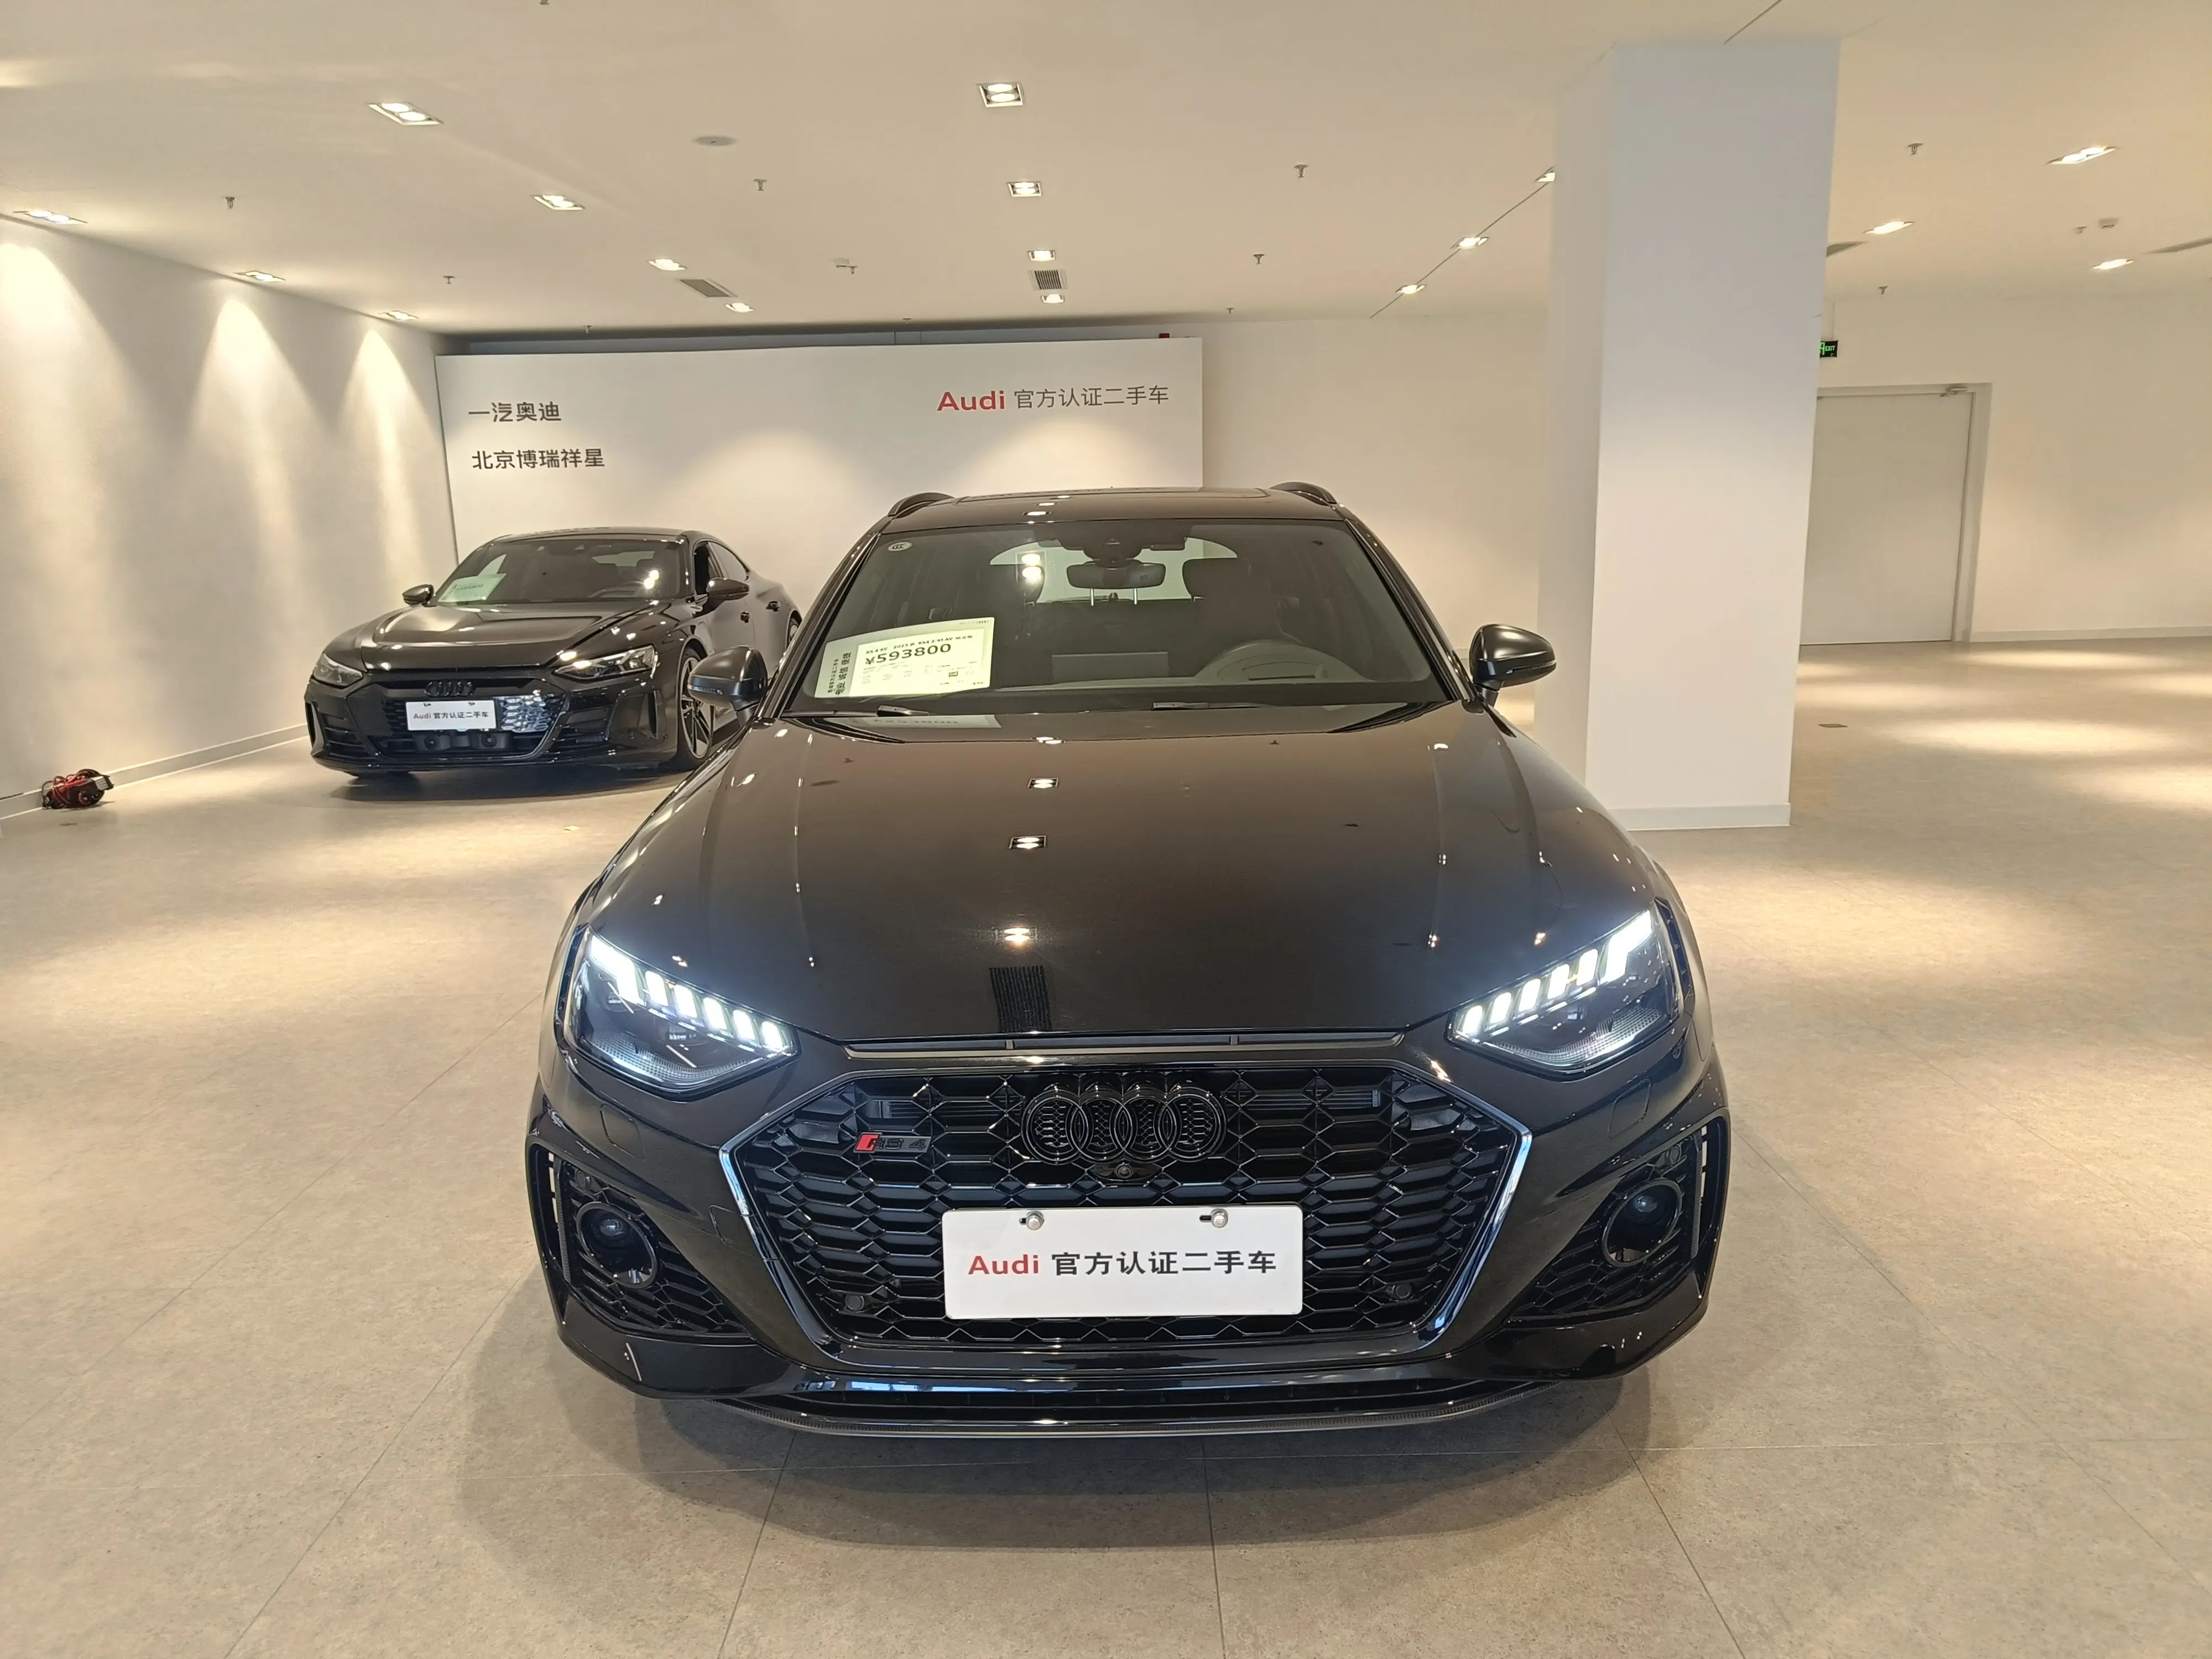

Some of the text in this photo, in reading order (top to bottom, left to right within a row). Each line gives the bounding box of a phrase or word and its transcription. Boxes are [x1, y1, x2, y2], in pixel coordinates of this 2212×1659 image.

[937, 385, 1169, 411] Audi 官方认证二手车
[468, 401, 561, 422] 一汽奥迪
[471, 448, 605, 469] 北京博瑞祥星
[865, 643, 951, 665] ¥593800
[968, 1250, 1277, 1276] Audi 官方认证二手车
